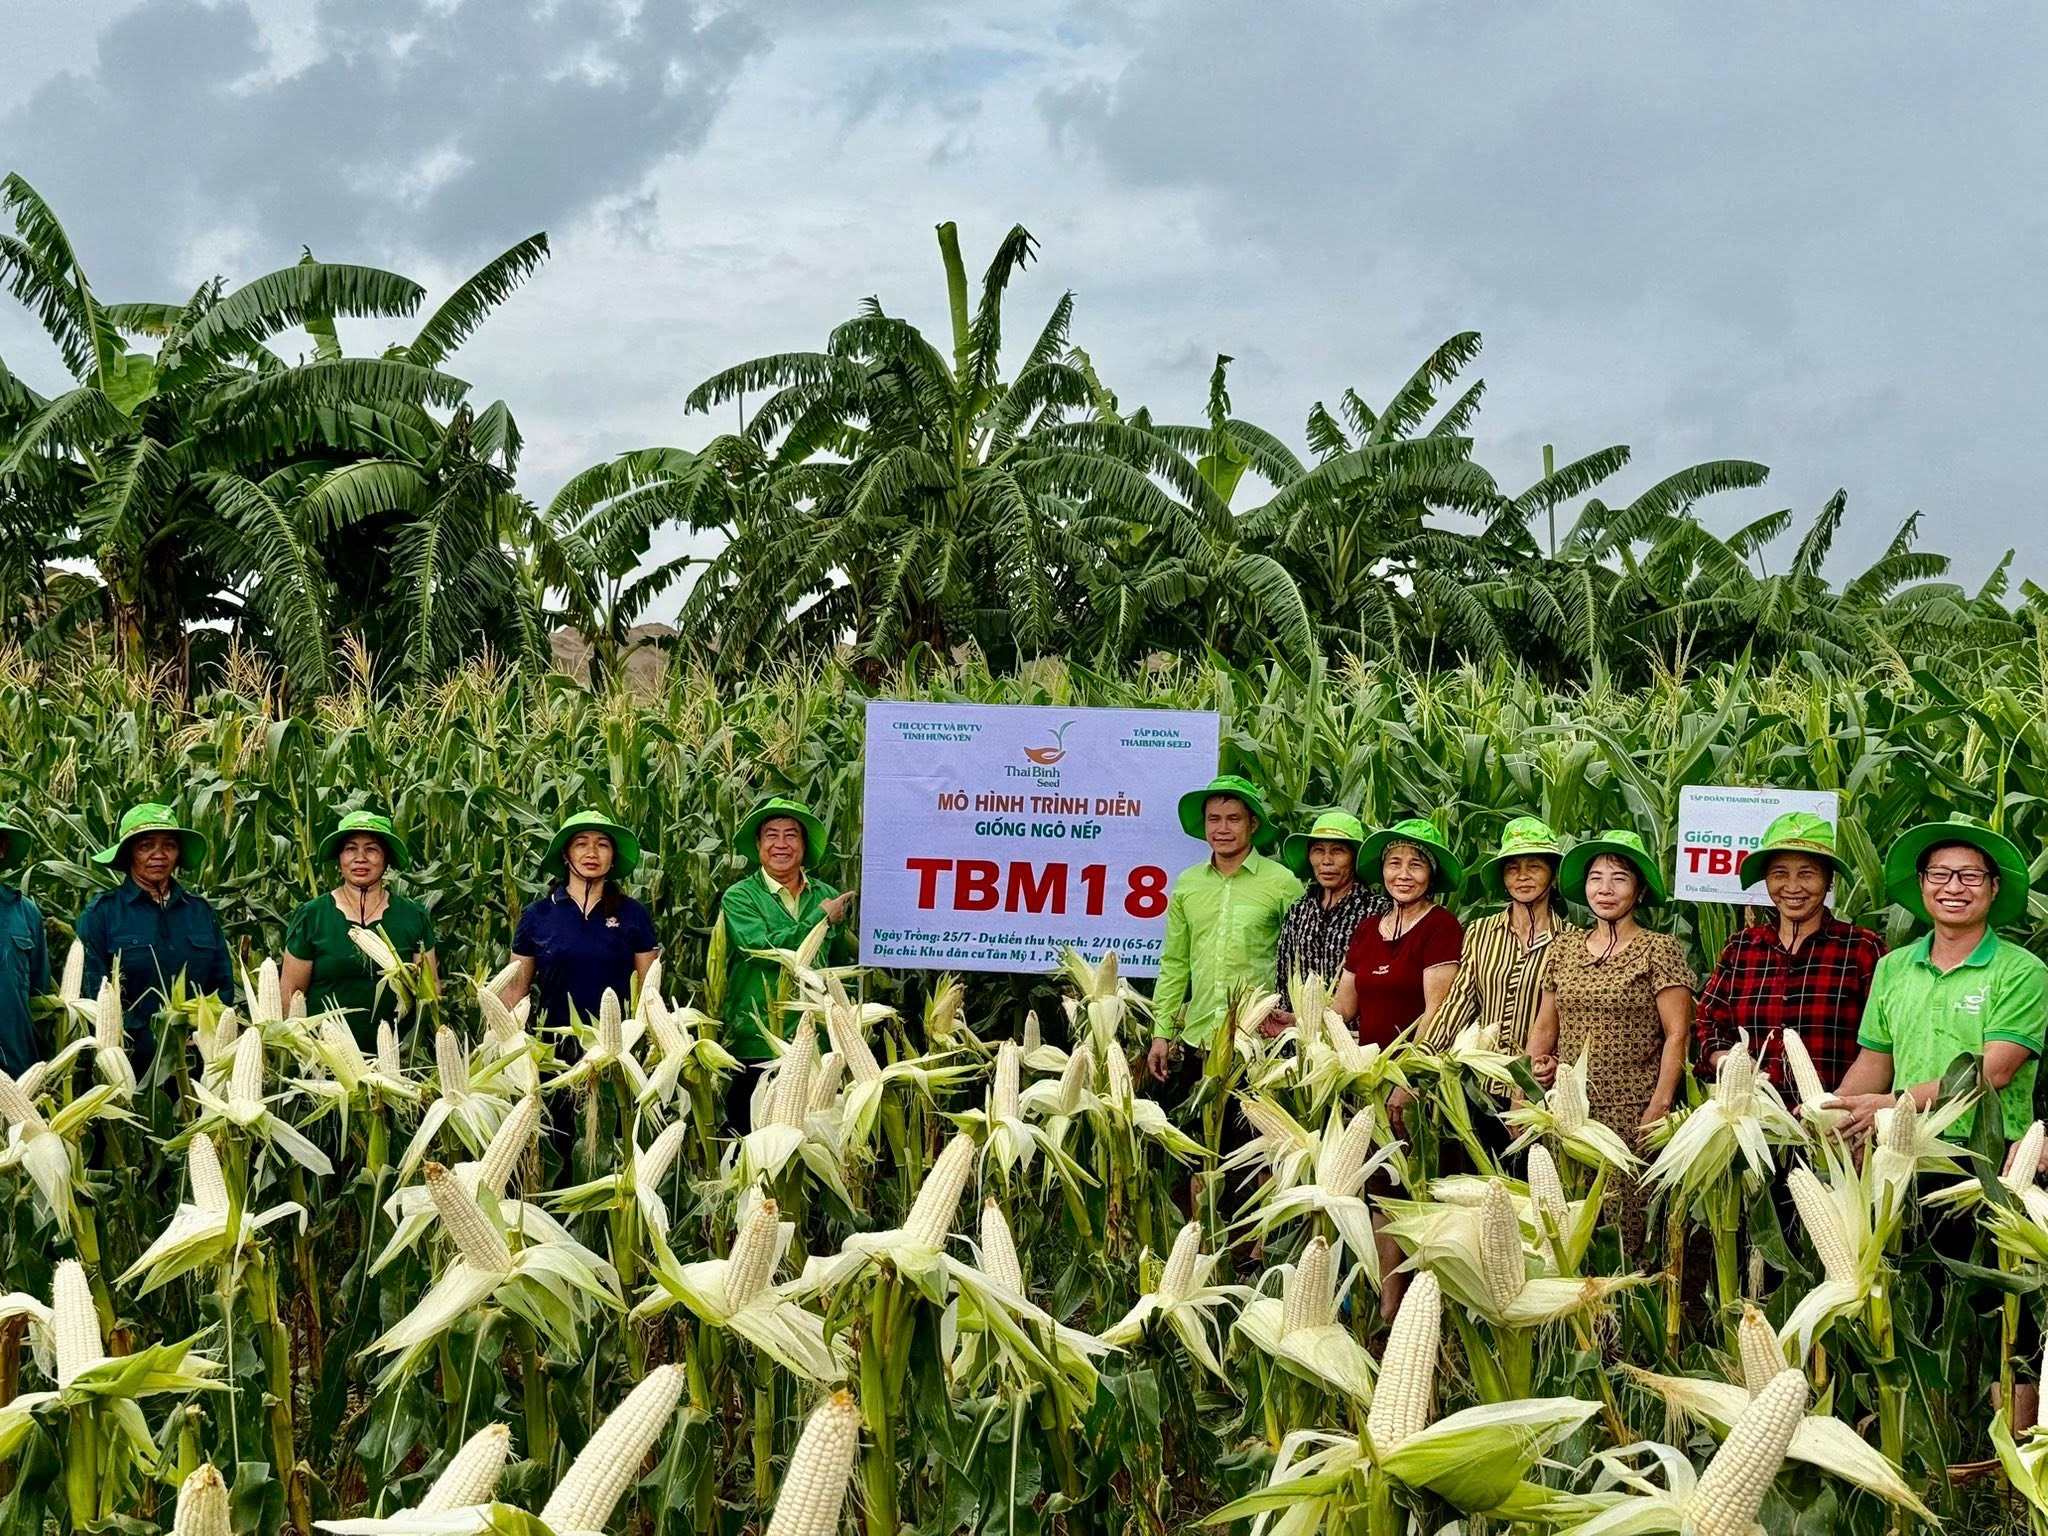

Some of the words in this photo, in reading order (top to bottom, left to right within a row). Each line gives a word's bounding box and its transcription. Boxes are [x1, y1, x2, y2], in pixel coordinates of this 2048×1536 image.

[892, 722, 910, 730] CHI
[1166, 740, 1192, 749] SEED
[1036, 778, 1060, 788] Seed
[938, 790, 969, 812] MÔ
[974, 790, 1024, 813] HÌNH
[1030, 792, 1088, 815] TRÌNH
[1095, 792, 1141, 816] DIỄN
[974, 816, 1026, 837] GIỐNG
[1030, 820, 1066, 838] NGÔ
[1071, 820, 1102, 840] NẾP
[1684, 830, 1732, 847] Giống
[872, 928, 900, 942] Ngày
[904, 928, 940, 944] Trồng:
[942, 931, 970, 943] 25/7
[978, 933, 996, 947] Dự
[998, 930, 1022, 945] kiến
[1024, 934, 1045, 946] thu
[1092, 936, 1120, 950] 2/10
[1122, 938, 1162, 951] (65-67
[872, 944, 894, 958] Địa
[920, 945, 944, 957] Khu
[946, 948, 969, 958] dân
[987, 949, 1007, 960] Tân
[1010, 949, 1027, 962] Mỹ
